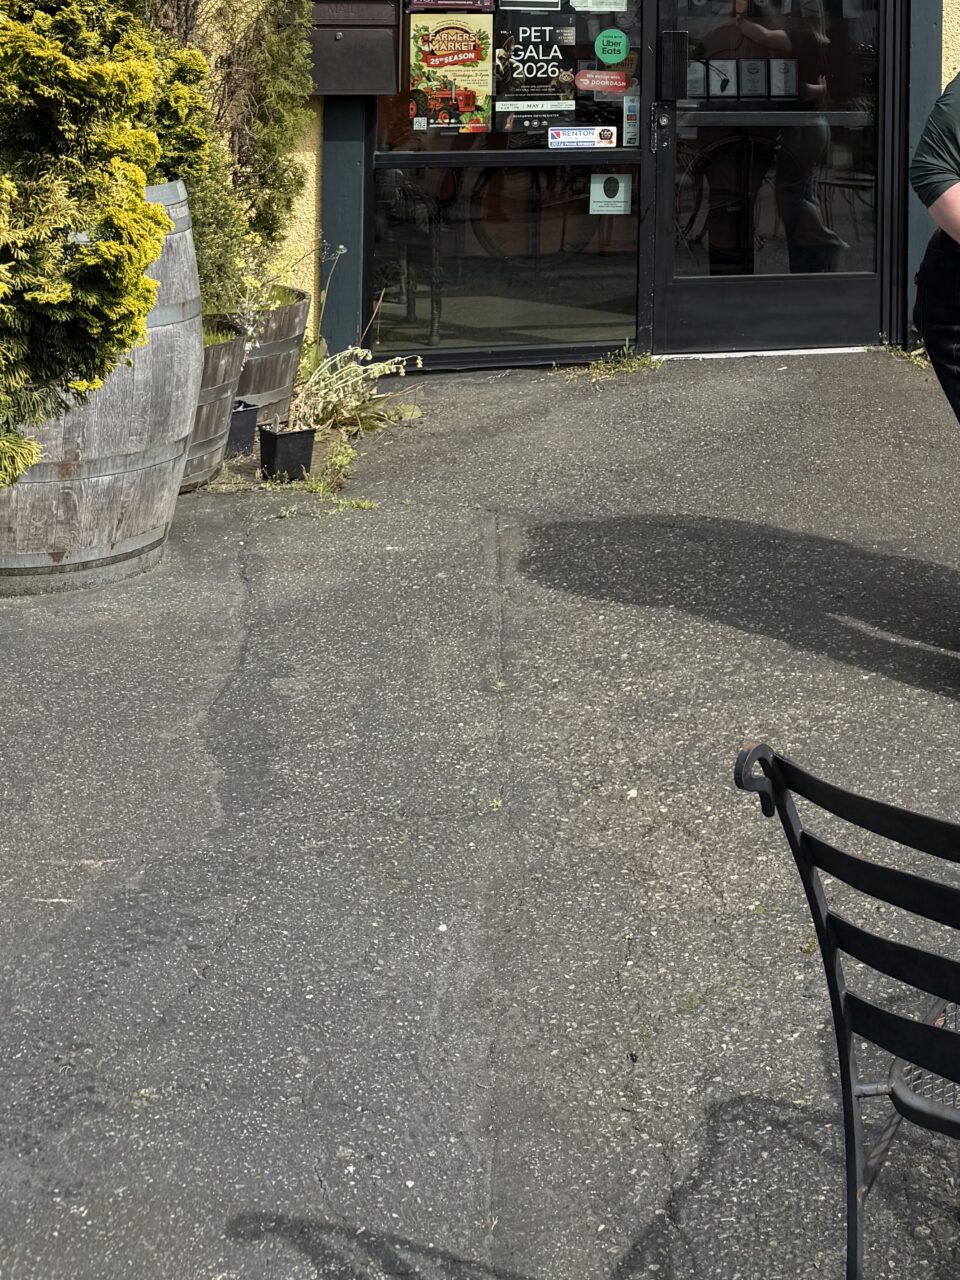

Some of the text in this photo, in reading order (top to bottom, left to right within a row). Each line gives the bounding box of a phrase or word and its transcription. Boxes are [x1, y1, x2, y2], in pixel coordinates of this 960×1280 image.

[327, 3, 355, 15] MAIL
[429, 33, 476, 41] FARMERS
[519, 27, 554, 42] PET
[429, 41, 476, 51] MARKET
[602, 39, 622, 47] Uber
[511, 45, 563, 60] GALA
[601, 47, 622, 55] Eats
[444, 52, 475, 64] SEASON
[512, 62, 560, 78] 2026
[591, 79, 627, 87] DOORDASH
